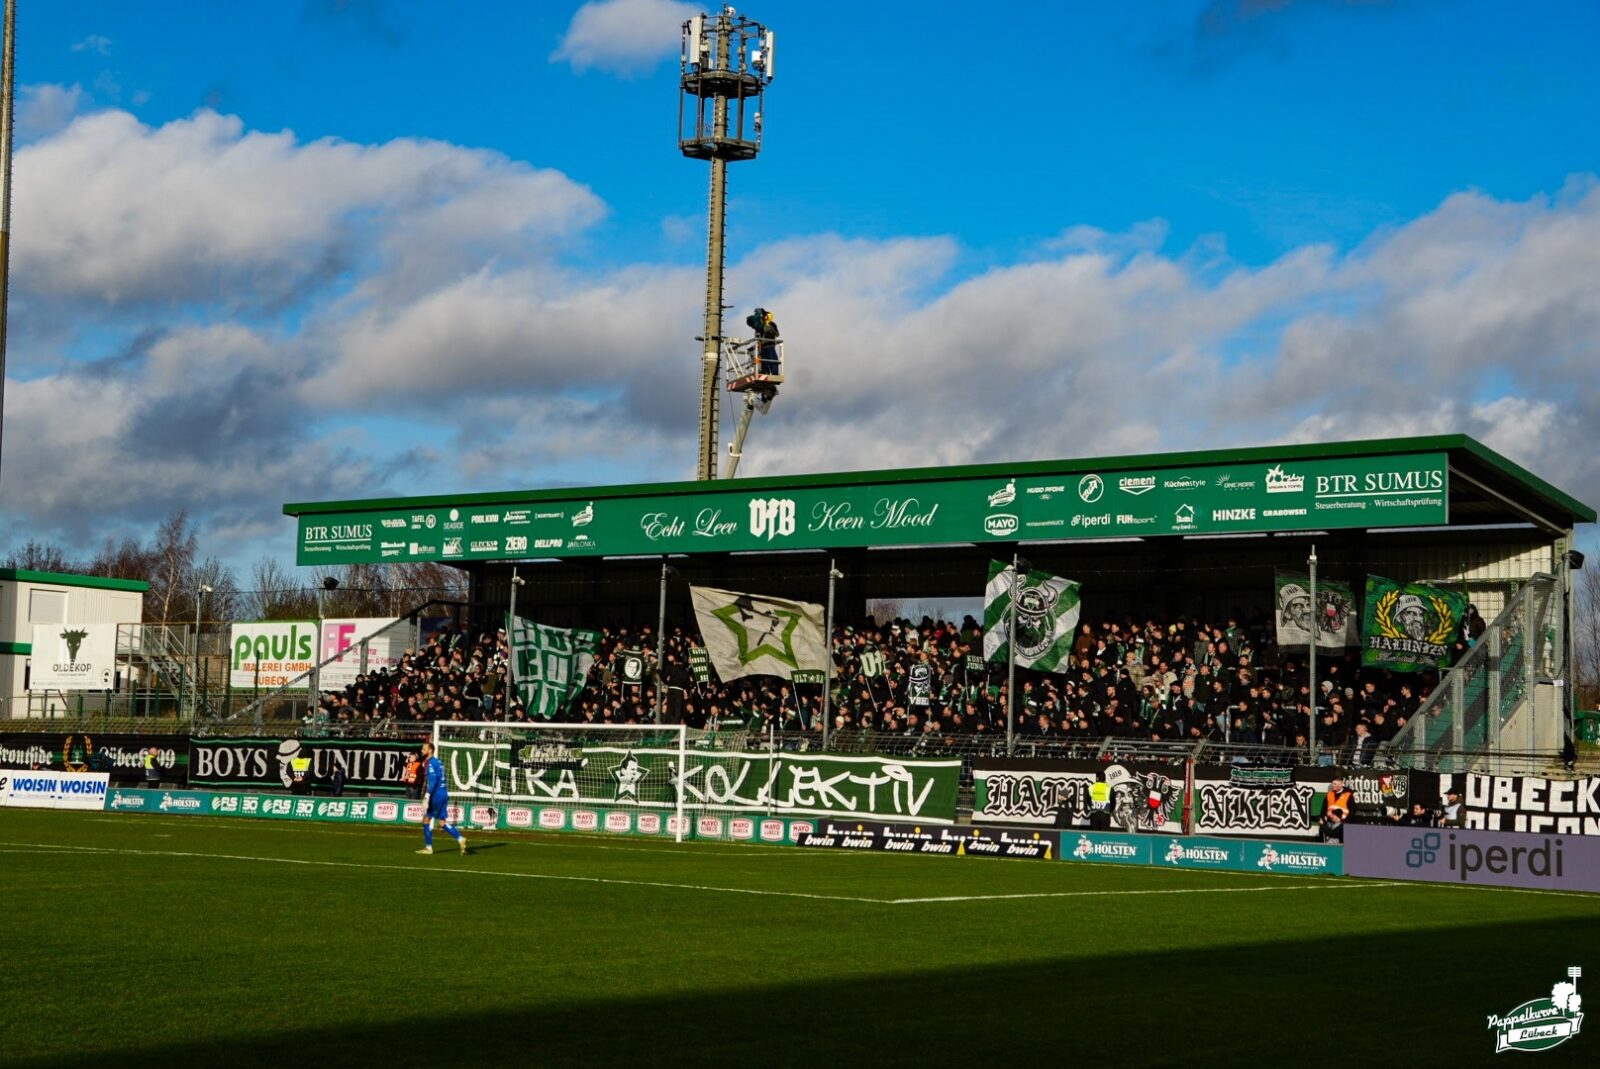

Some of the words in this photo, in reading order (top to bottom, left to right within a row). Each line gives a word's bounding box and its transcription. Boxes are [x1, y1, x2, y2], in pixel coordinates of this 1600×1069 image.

[1119, 476, 1156, 487] clement
[1316, 474, 1359, 493] BTR
[1364, 470, 1443, 491] SUMUS
[1315, 501, 1366, 510] Steuerberatung
[1373, 497, 1442, 508] Wirtschaftsprüfung
[1213, 508, 1256, 522] HINZKE
[1263, 508, 1307, 517] GRABOWSKI
[640, 512, 686, 541] Echt
[807, 501, 865, 531] Keen
[869, 498, 939, 530] Mood
[987, 519, 1015, 529] MAYO
[1081, 513, 1110, 528] iperdi
[305, 526, 328, 540] BTR
[331, 524, 372, 539] SUMUS
[233, 625, 312, 670] pauls
[52, 663, 92, 672] OLDEKOP
[196, 747, 268, 778] BOYS
[13, 778, 57, 792] WOISIN
[60, 780, 107, 794] WOISIN
[668, 760, 935, 816] KOLLEKTIV
[122, 797, 145, 806] HOLSTEN
[173, 799, 201, 808] HOLSTEN
[242, 800, 258, 810] 30
[296, 803, 314, 814] 30
[351, 804, 368, 815] 30
[804, 834, 835, 846] bwin
[841, 836, 873, 848] bwin
[884, 839, 915, 851] bwin
[969, 840, 1000, 852] bwin
[921, 841, 952, 853] bwin
[1006, 843, 1039, 856] bwin
[1094, 844, 1137, 856] HOLSTEN
[1185, 848, 1228, 861] HOLSTEN
[1449, 833, 1563, 881] iperdi
[1280, 855, 1327, 867] HOLSTEN
